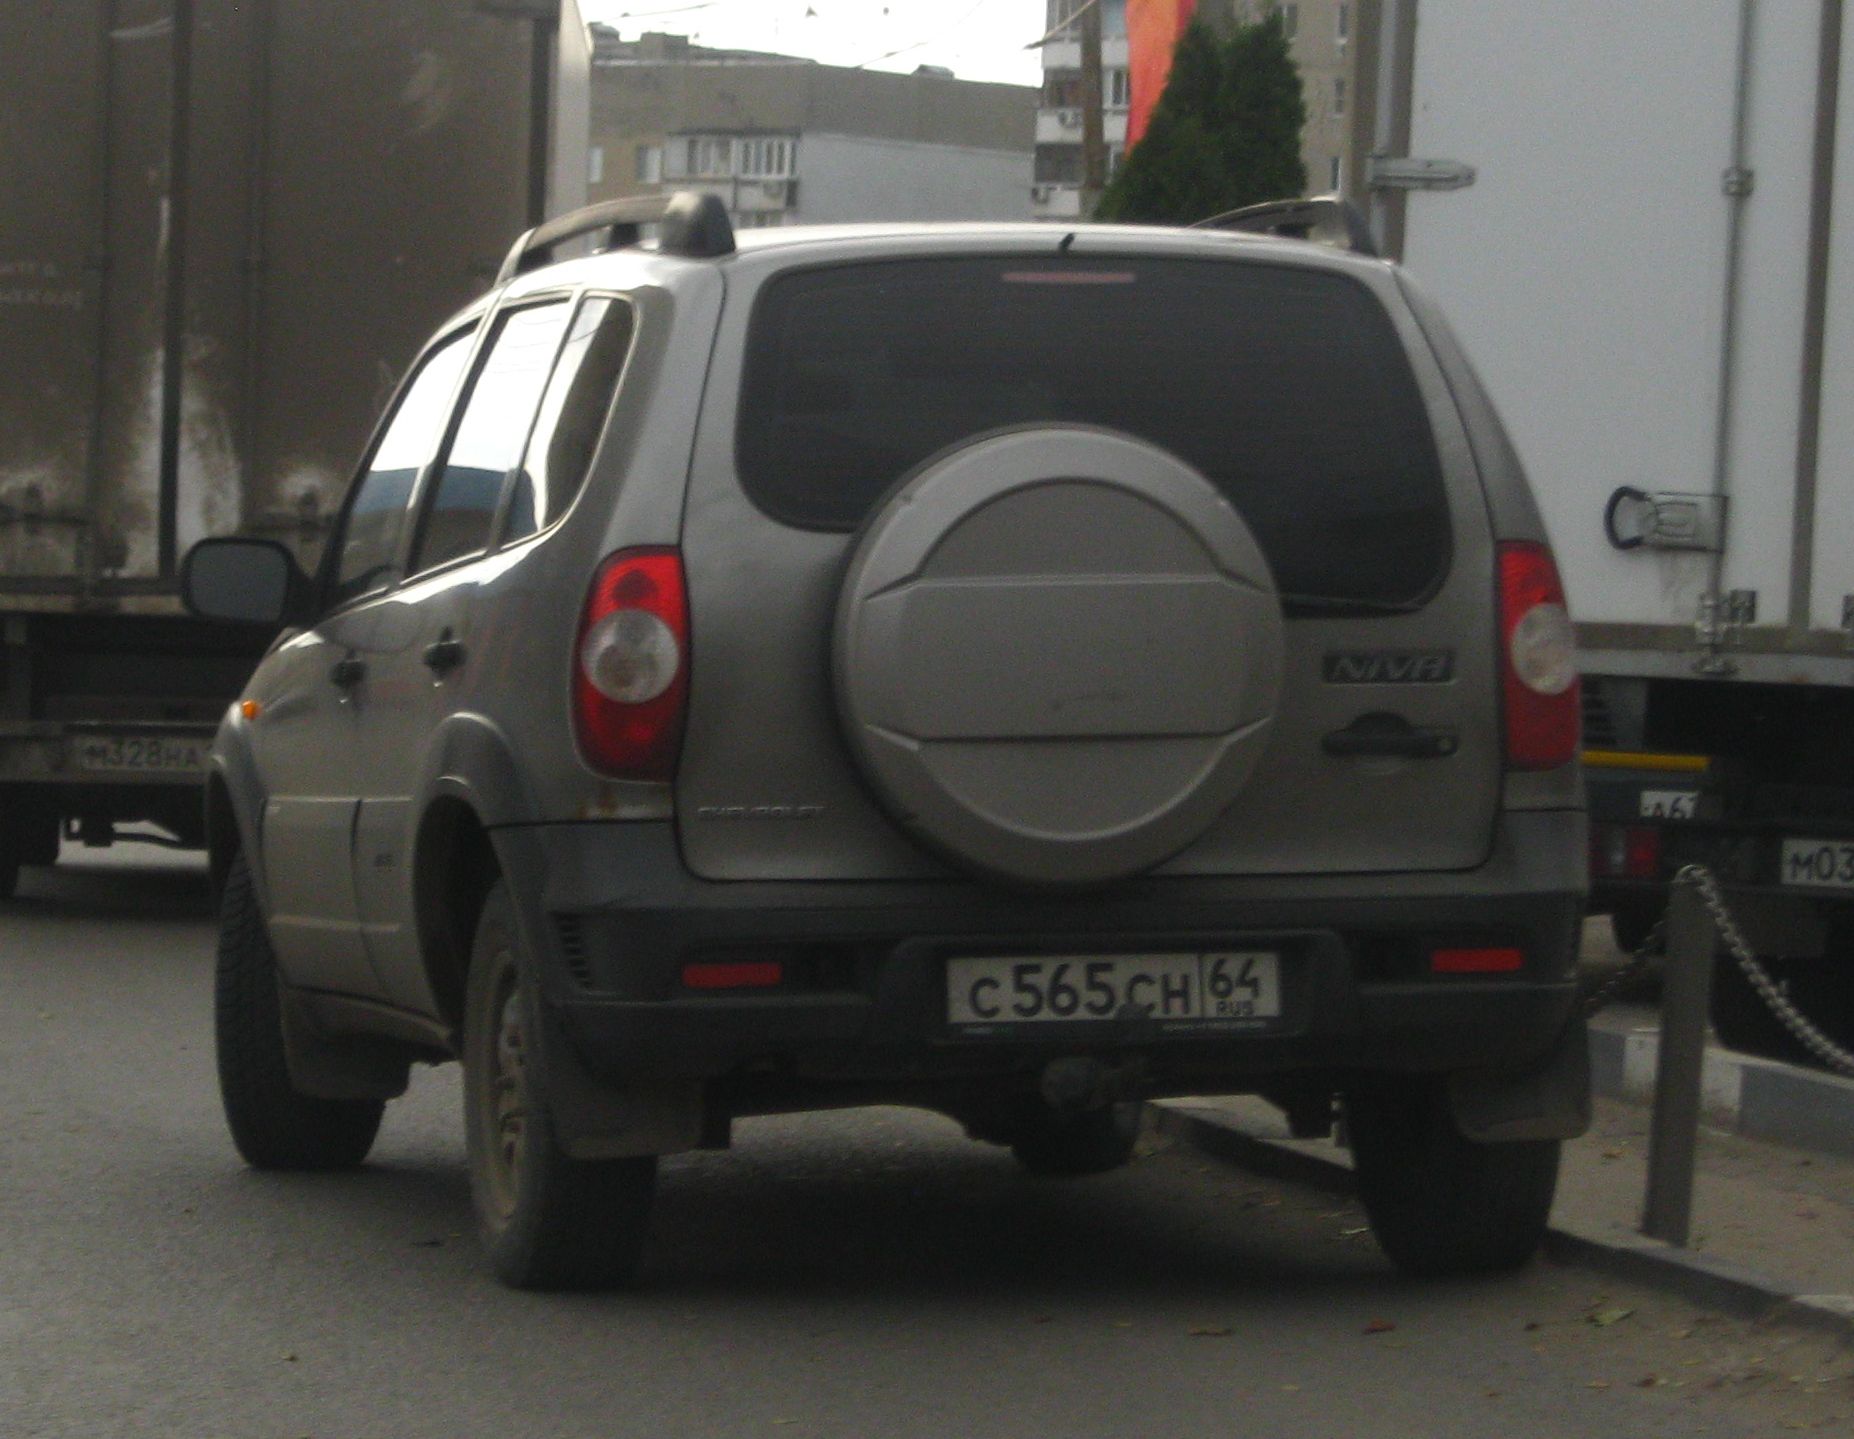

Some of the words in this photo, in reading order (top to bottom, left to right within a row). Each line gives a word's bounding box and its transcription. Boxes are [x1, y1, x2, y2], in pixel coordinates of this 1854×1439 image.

[1330, 654, 1447, 680] NIVA
[968, 962, 1190, 1019] C565CH
[1208, 957, 1260, 999] 64
